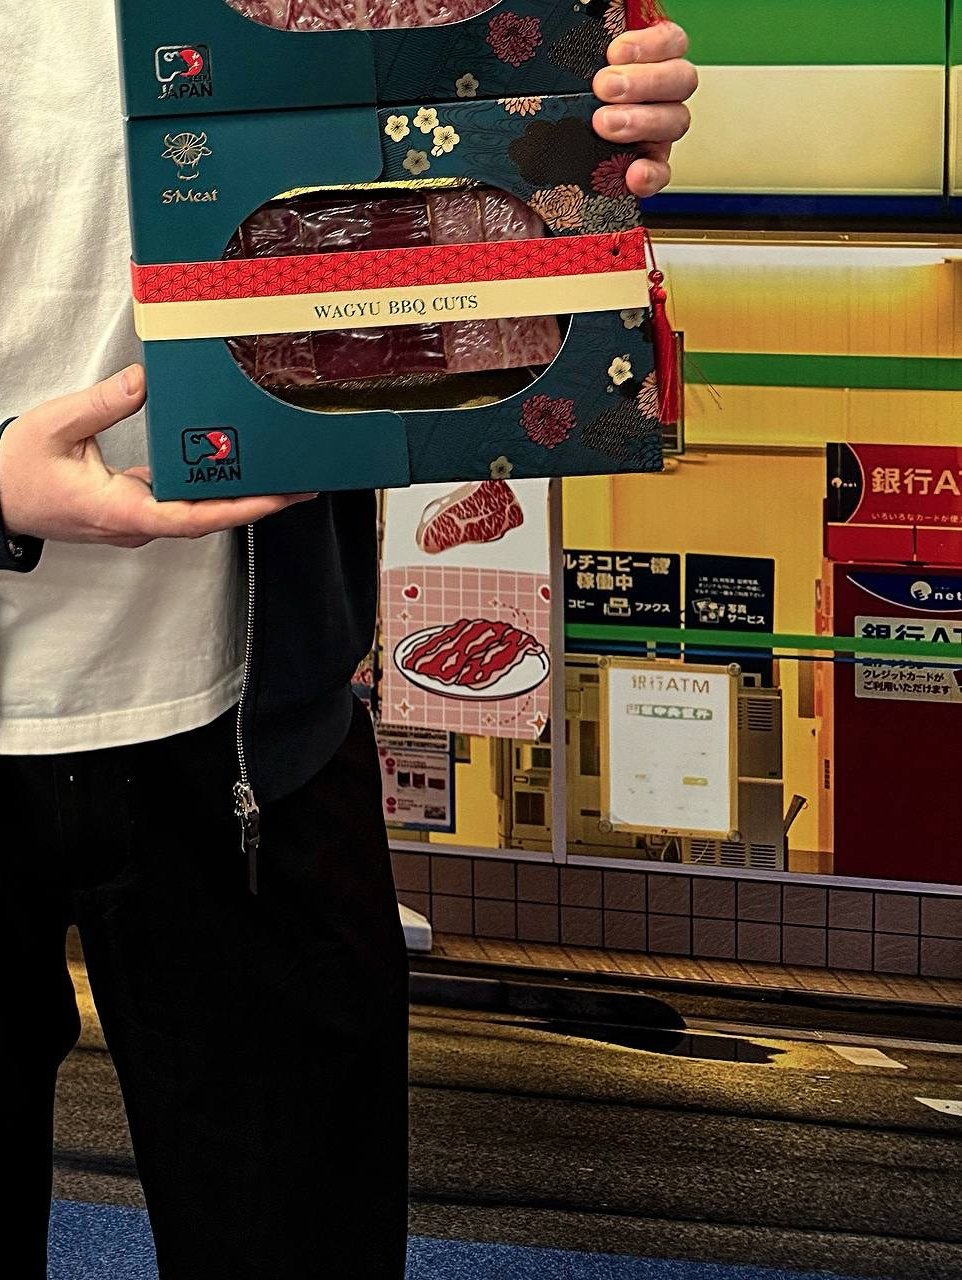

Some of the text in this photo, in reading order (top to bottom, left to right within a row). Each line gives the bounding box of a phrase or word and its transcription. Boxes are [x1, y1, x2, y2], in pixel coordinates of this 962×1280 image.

[157, 83, 213, 100] JAPAN
[314, 295, 479, 319] WAGYU BBQ CUTS
[184, 465, 242, 484] JAPAN
[871, 466, 962, 496] 銀行A
[576, 571, 633, 591] 稼働中
[568, 599, 595, 609] コピー
[635, 602, 671, 613] ファクス
[727, 614, 766, 625] サービス
[863, 669, 945, 682] クレジットカードが
[863, 681, 951, 695] ご利用いただけます
